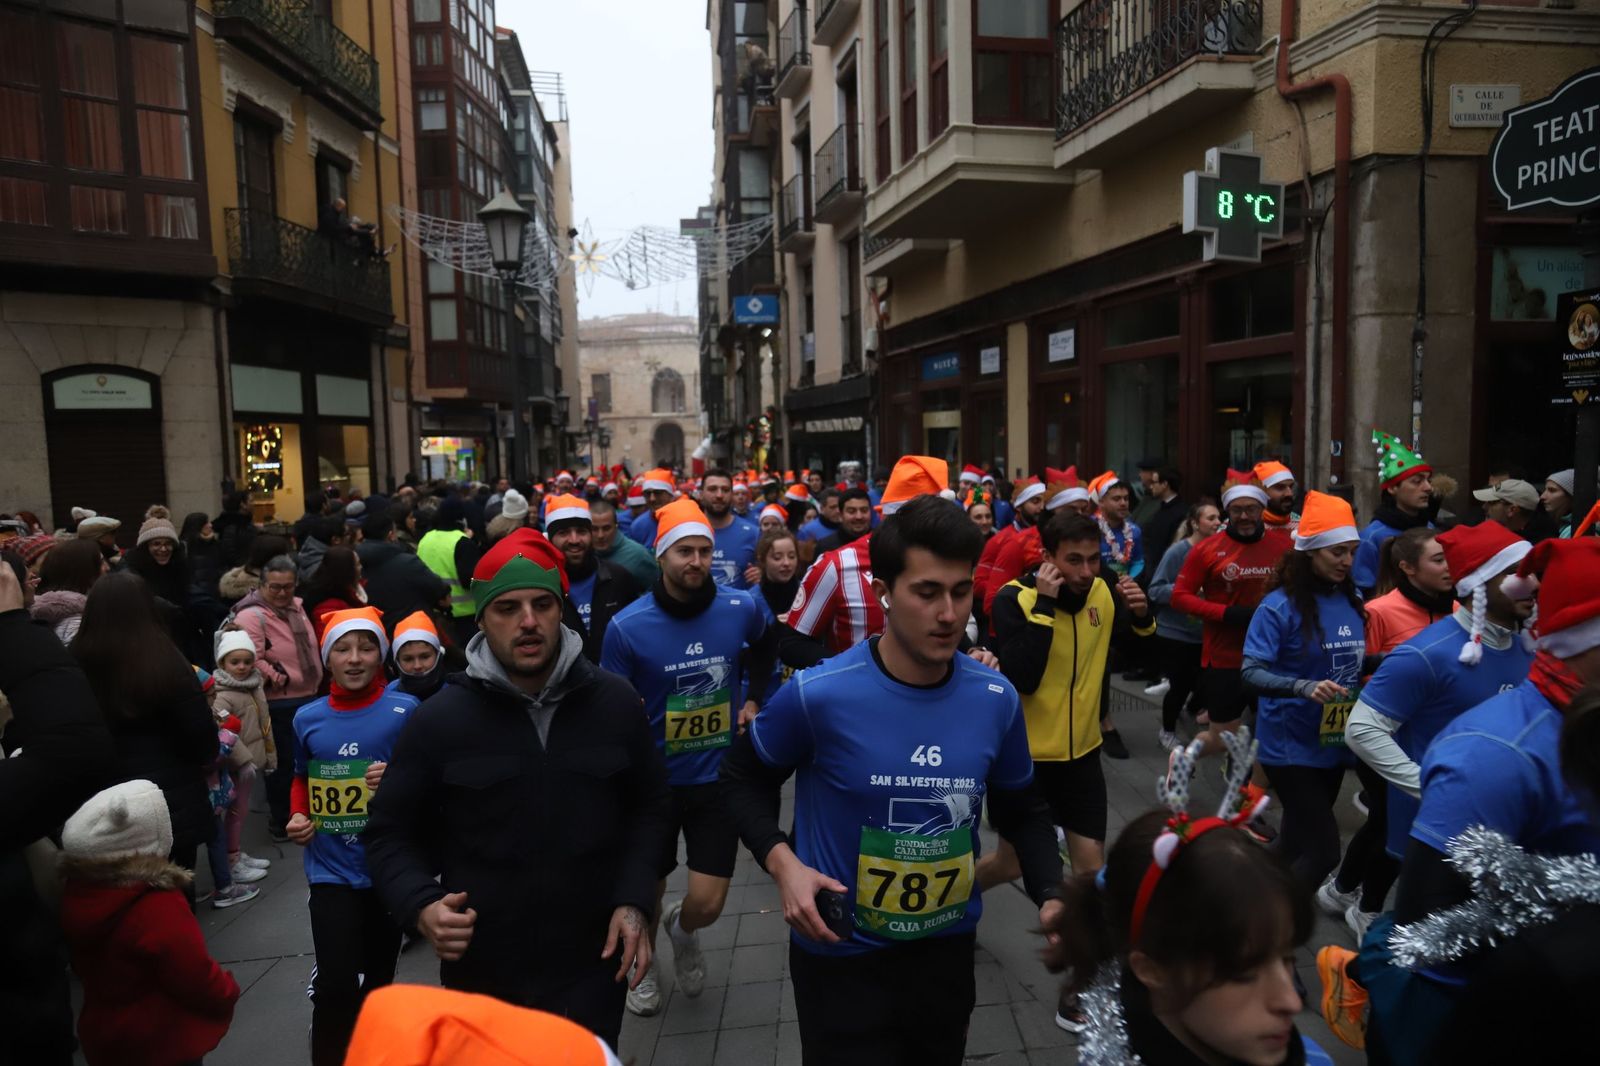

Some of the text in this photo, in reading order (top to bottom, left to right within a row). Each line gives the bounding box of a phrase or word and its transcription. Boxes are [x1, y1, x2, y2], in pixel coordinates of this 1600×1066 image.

[1475, 91, 1504, 99] CALLE
[1480, 102, 1493, 110] DE
[1454, 113, 1504, 121] QUEBRANTAHU
[1533, 104, 1600, 146] TEAT
[1517, 145, 1600, 190] PRINC
[1218, 190, 1275, 223] 8 °C
[1537, 260, 1554, 272] Un
[1565, 276, 1582, 290] de
[577, 603, 591, 615] 46
[1338, 625, 1352, 637] 46
[685, 642, 704, 656] 46
[664, 664, 677, 672] SAN
[678, 658, 709, 670] SILVESTRE
[671, 711, 721, 739] 786
[338, 742, 359, 757] 46
[910, 744, 943, 767] 46
[870, 774, 976, 788] SAN SILVESTRE 2025
[312, 785, 364, 815] 582
[323, 819, 369, 829] CAJA RURA
[894, 846, 949, 856] CAJA RURAL
[867, 867, 961, 913] 787
[888, 909, 960, 933] CAJA RURAL
